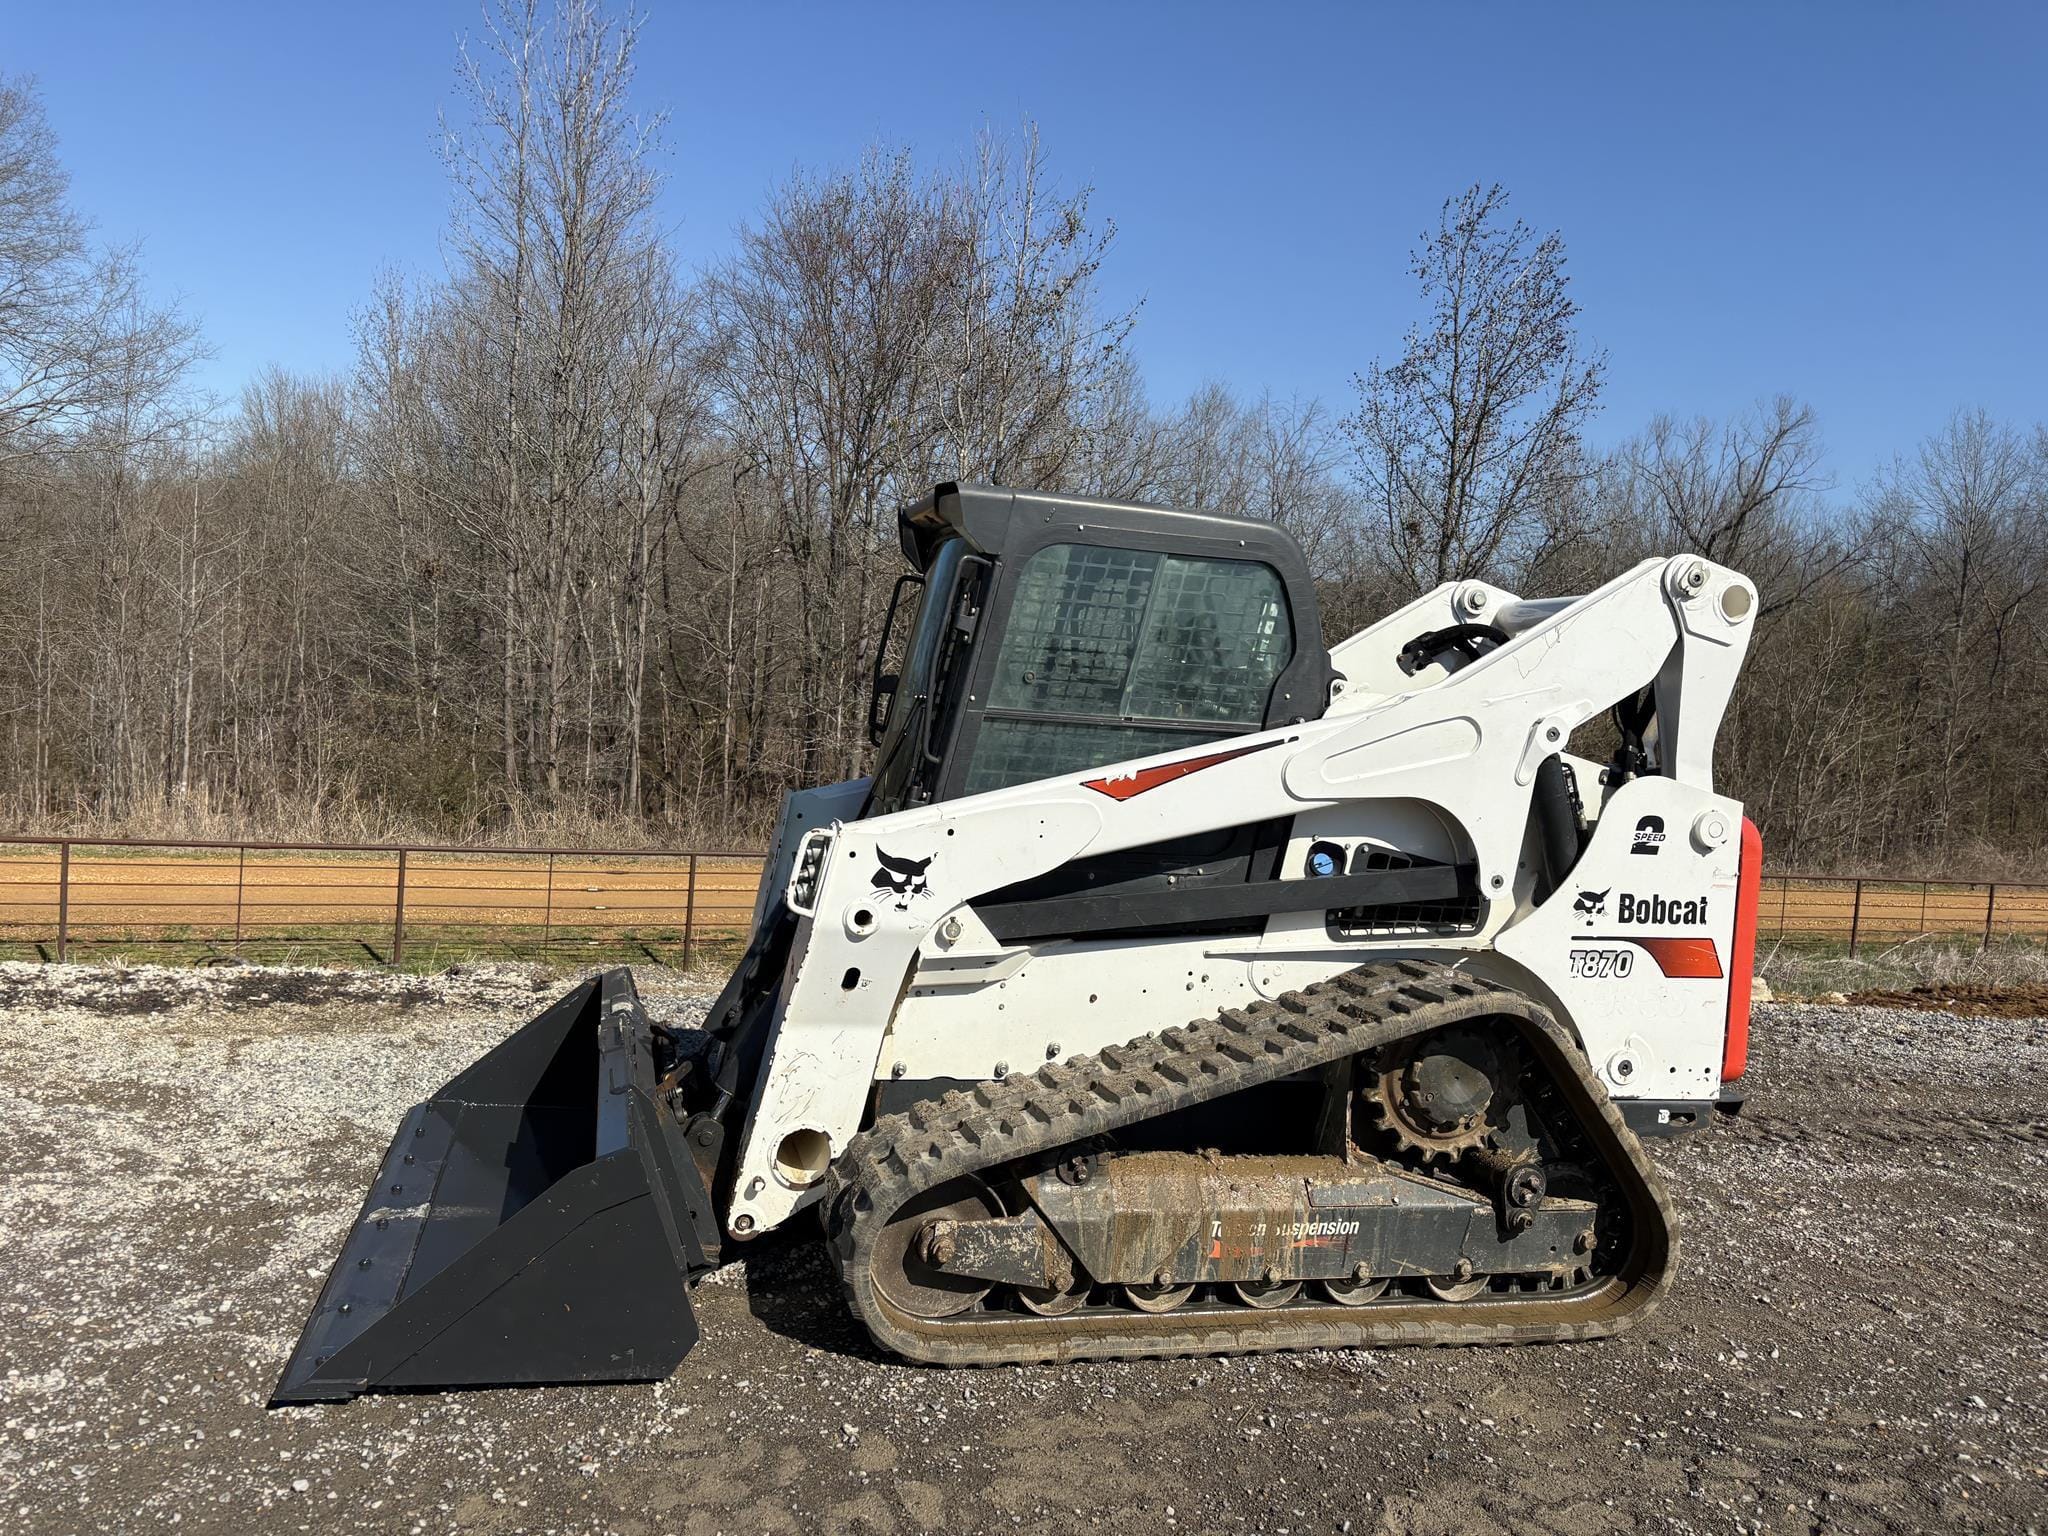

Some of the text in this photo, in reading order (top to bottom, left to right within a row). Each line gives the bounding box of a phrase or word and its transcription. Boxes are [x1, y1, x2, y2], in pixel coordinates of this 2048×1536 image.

[1630, 815, 1665, 855] 2
[1633, 832, 1666, 842] SPEED
[1618, 893, 1707, 925] Bobcat
[1570, 950, 1633, 978] T870
